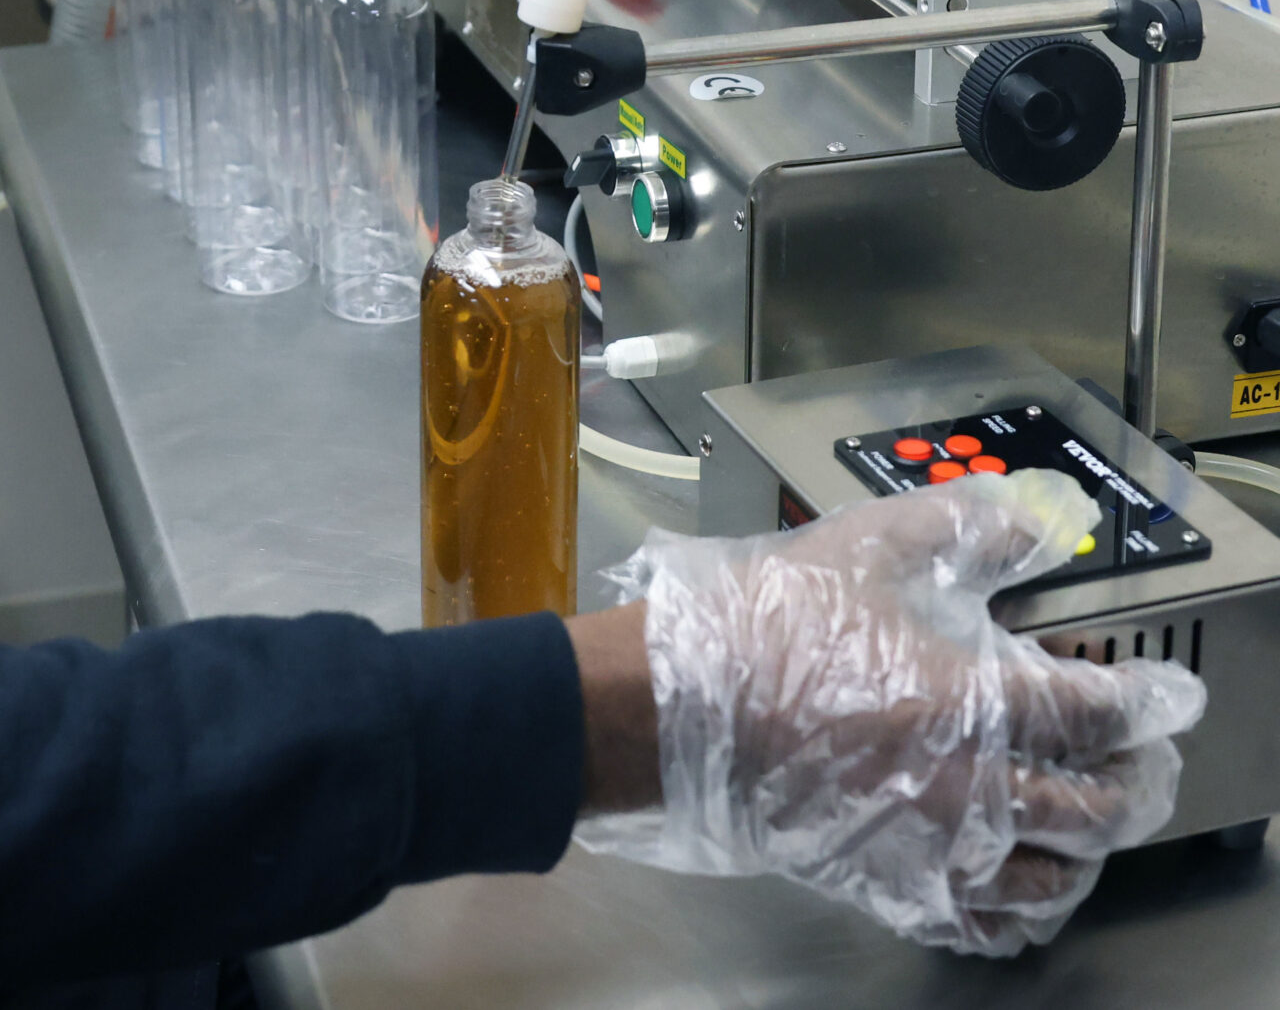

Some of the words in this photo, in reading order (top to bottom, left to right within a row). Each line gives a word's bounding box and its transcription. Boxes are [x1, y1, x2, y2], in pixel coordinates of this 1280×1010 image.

[663, 144, 682, 170] Power
[982, 418, 1004, 434] SPEED
[871, 451, 894, 470] POWER
[1062, 439, 1112, 477] VEVOR
